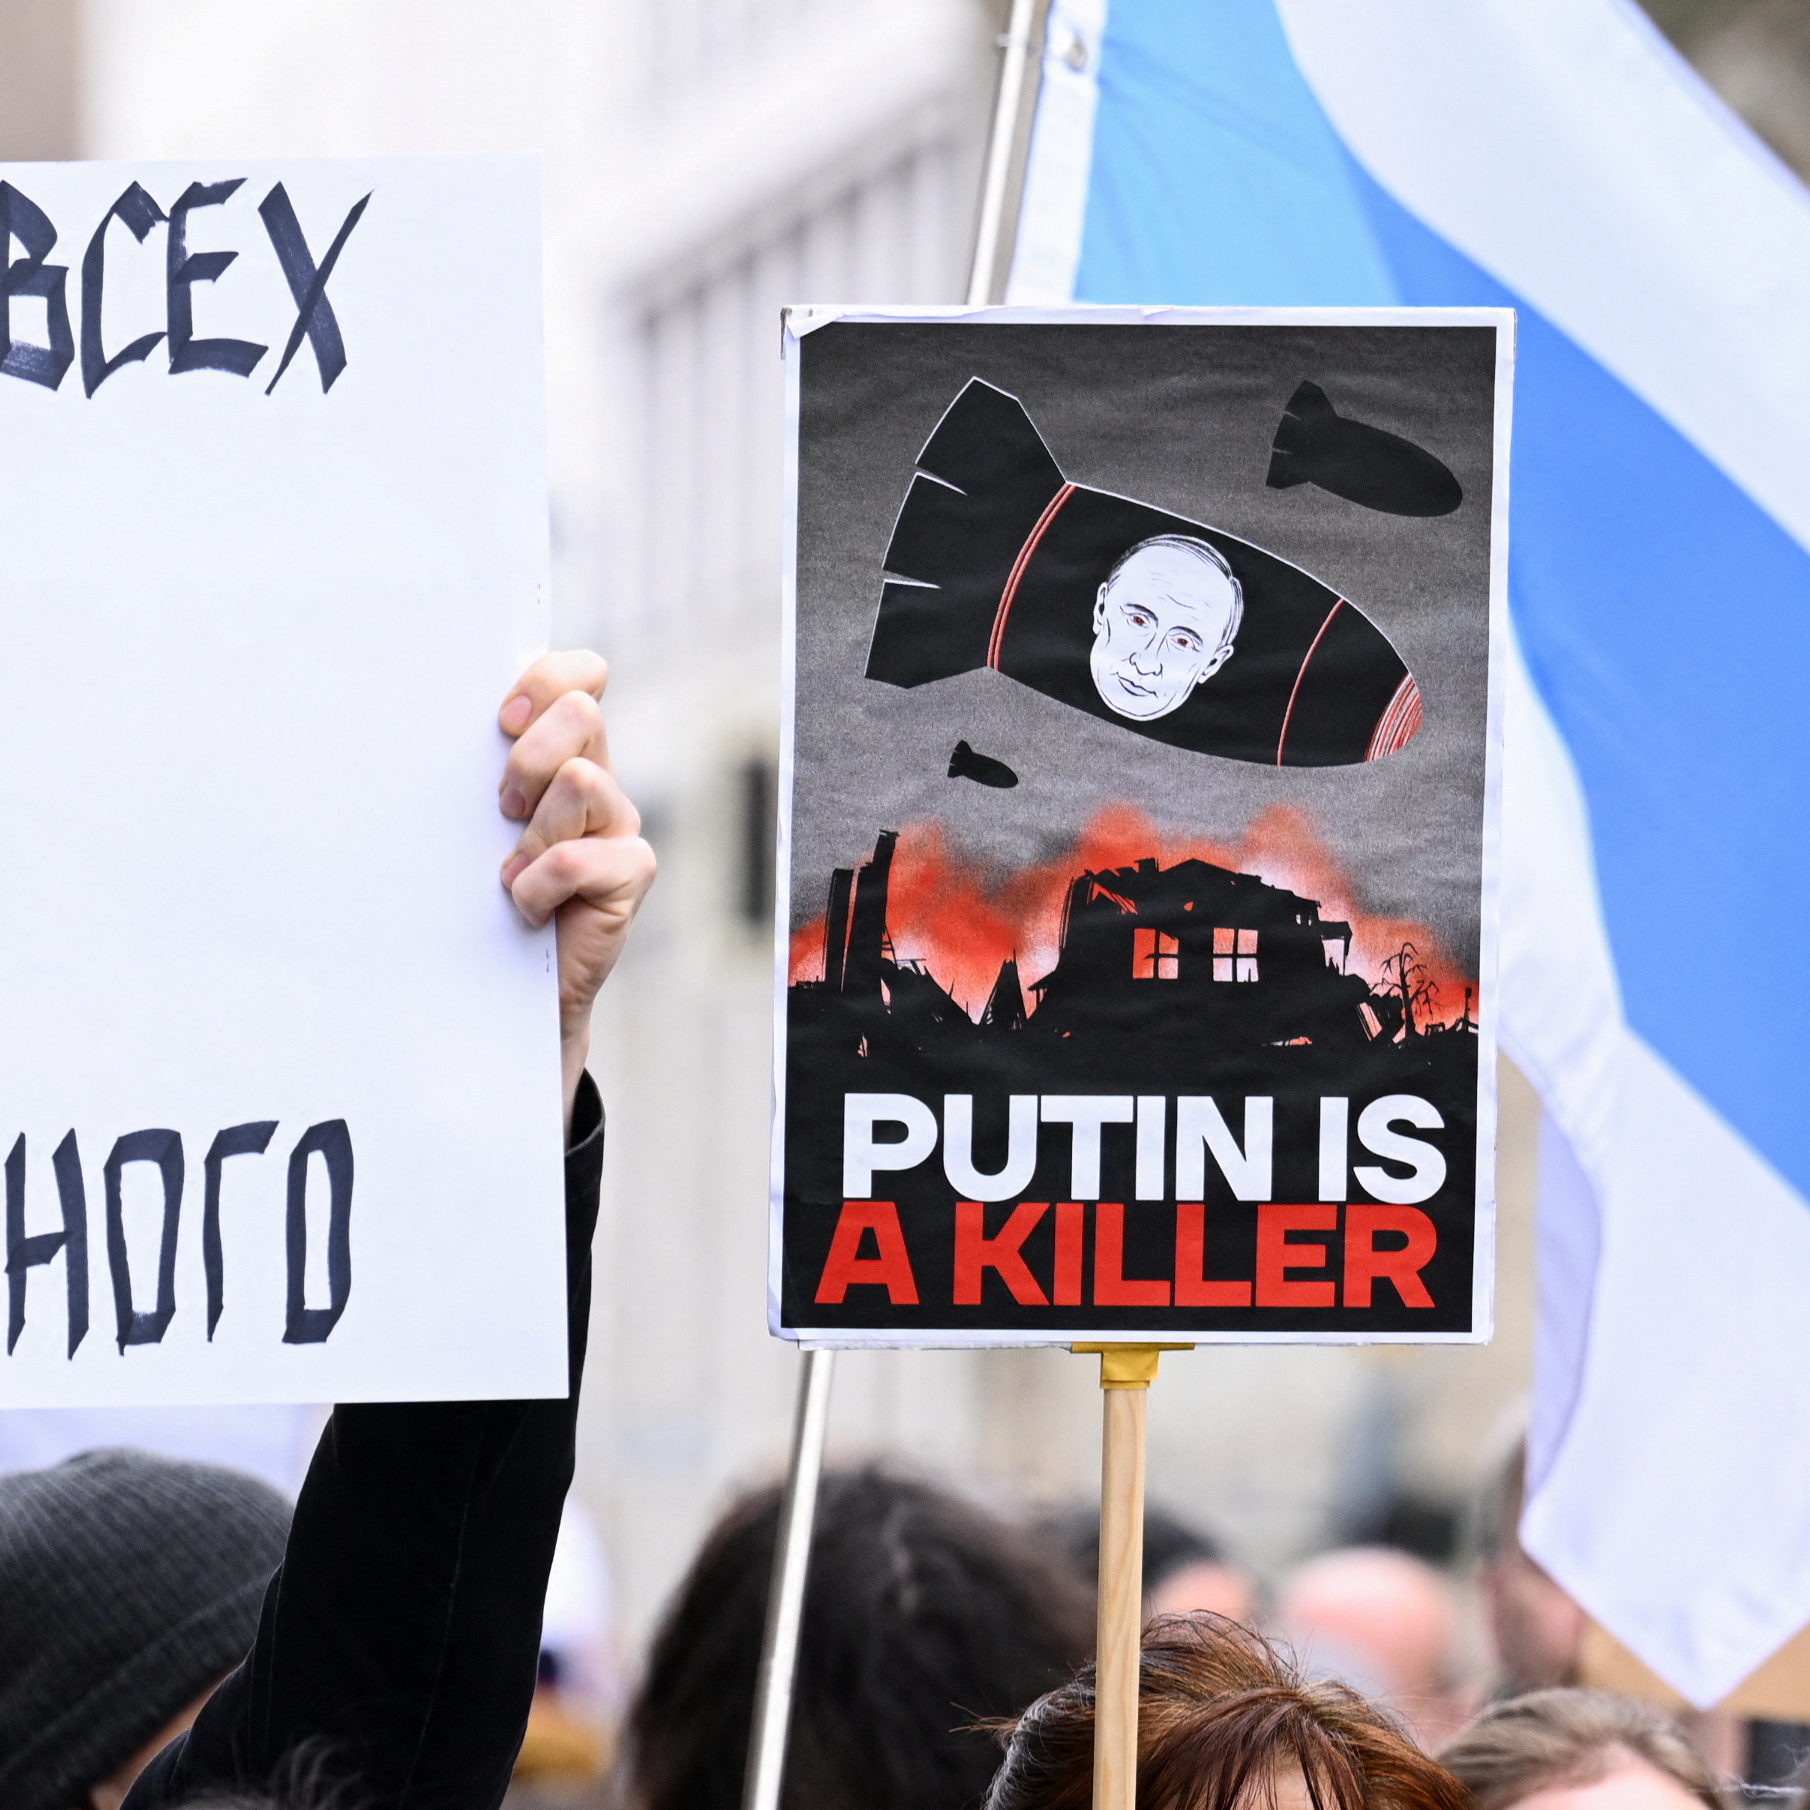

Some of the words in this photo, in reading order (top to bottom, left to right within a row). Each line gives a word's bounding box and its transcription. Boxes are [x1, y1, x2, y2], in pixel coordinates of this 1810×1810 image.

[842, 1092, 1274, 1203] PUTIN
[1318, 1094, 1447, 1205] IS
[814, 1201, 920, 1305] A
[953, 1201, 1438, 1308] KILLER
